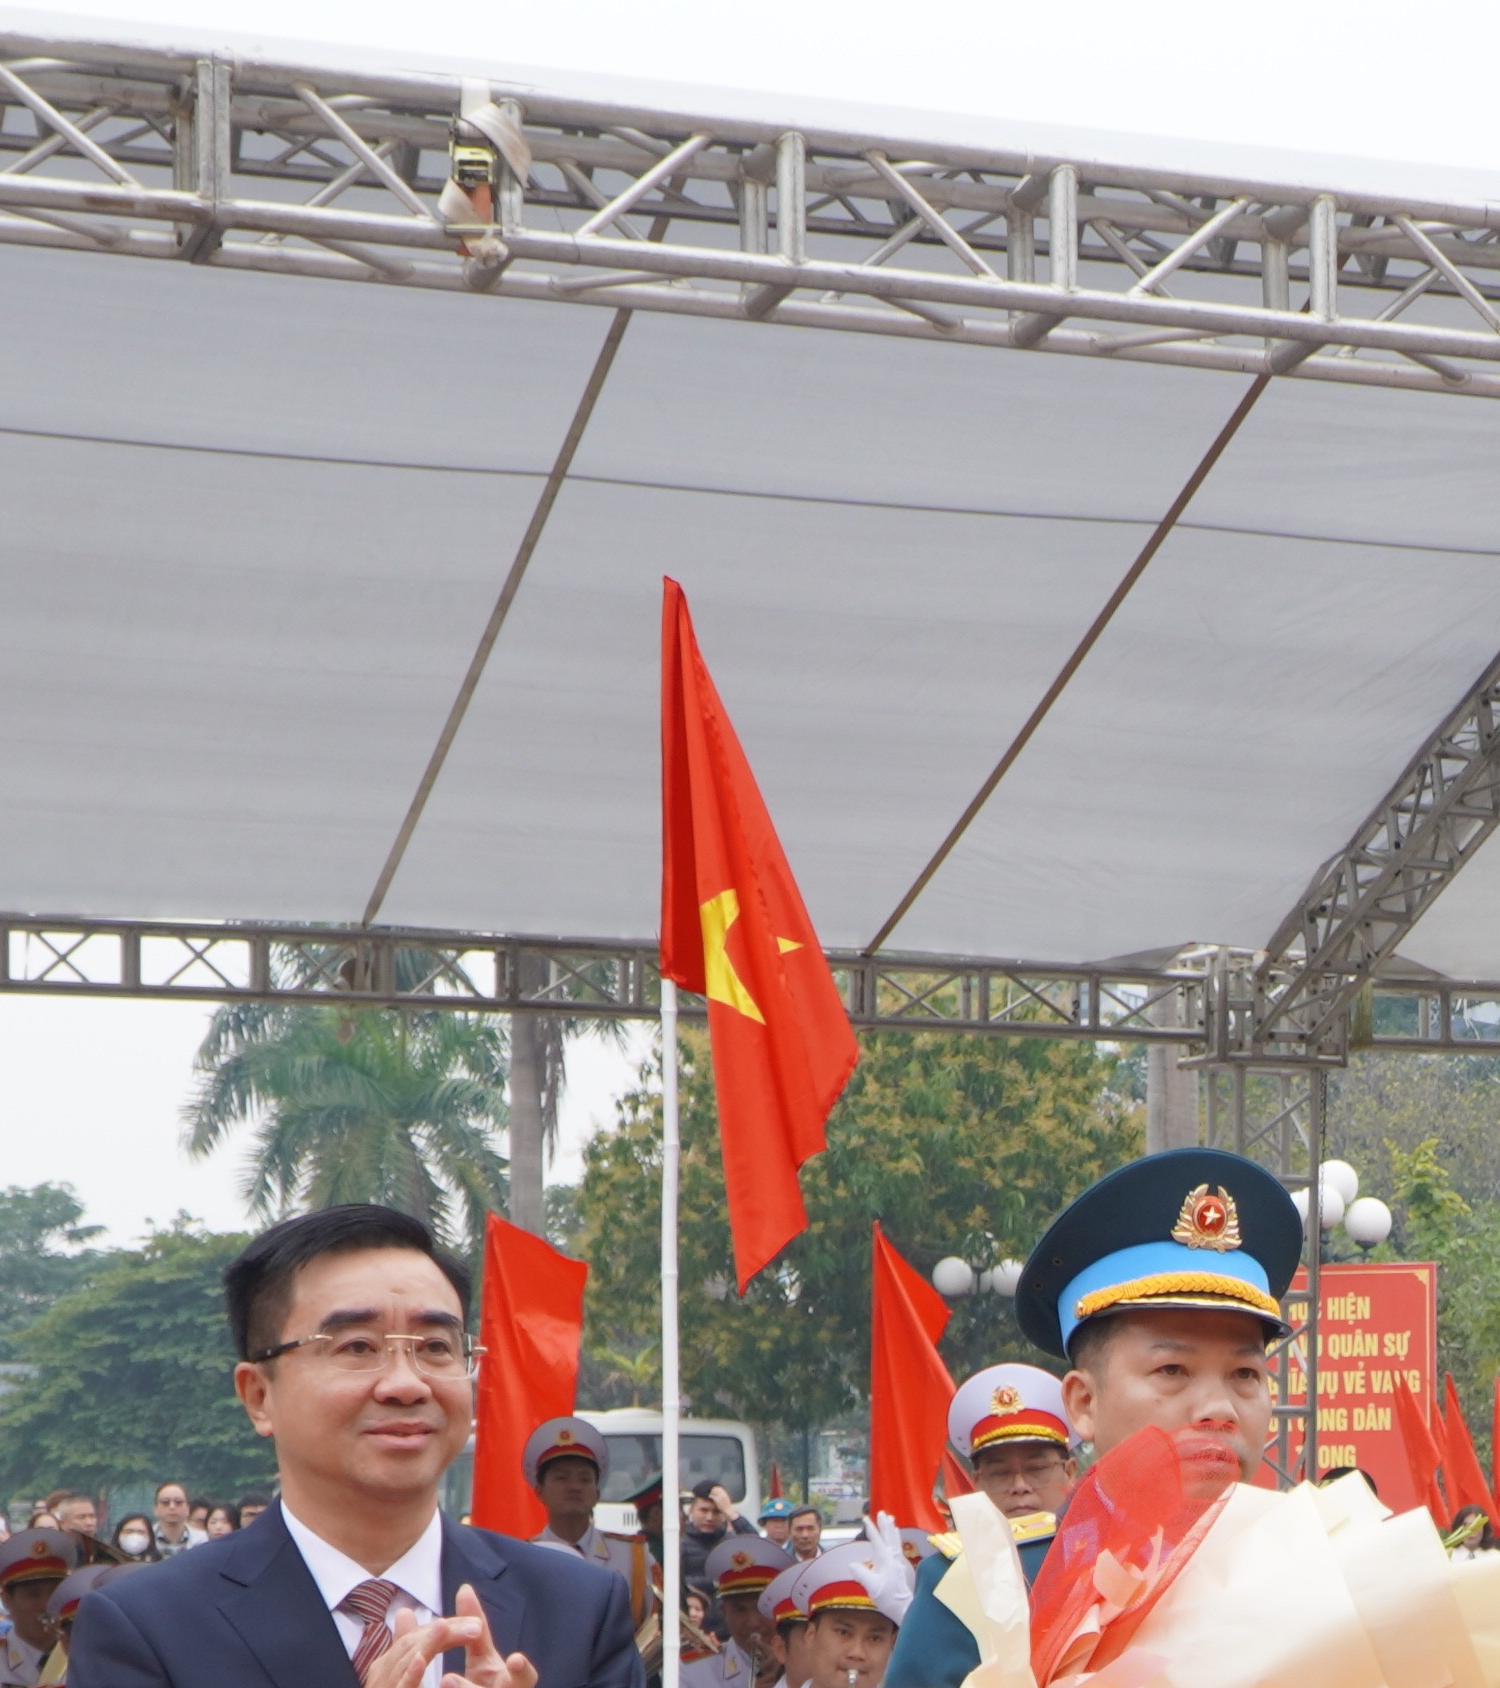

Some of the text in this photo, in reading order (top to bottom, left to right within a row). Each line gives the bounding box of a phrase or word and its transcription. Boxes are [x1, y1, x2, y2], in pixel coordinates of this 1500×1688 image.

[1327, 1292, 1370, 1325] HIỆN
[1328, 1329, 1378, 1360] QUÂN
[1383, 1330, 1411, 1361] SỰ
[1343, 1361, 1366, 1394] VẺ
[1353, 1403, 1391, 1432] DÂN
